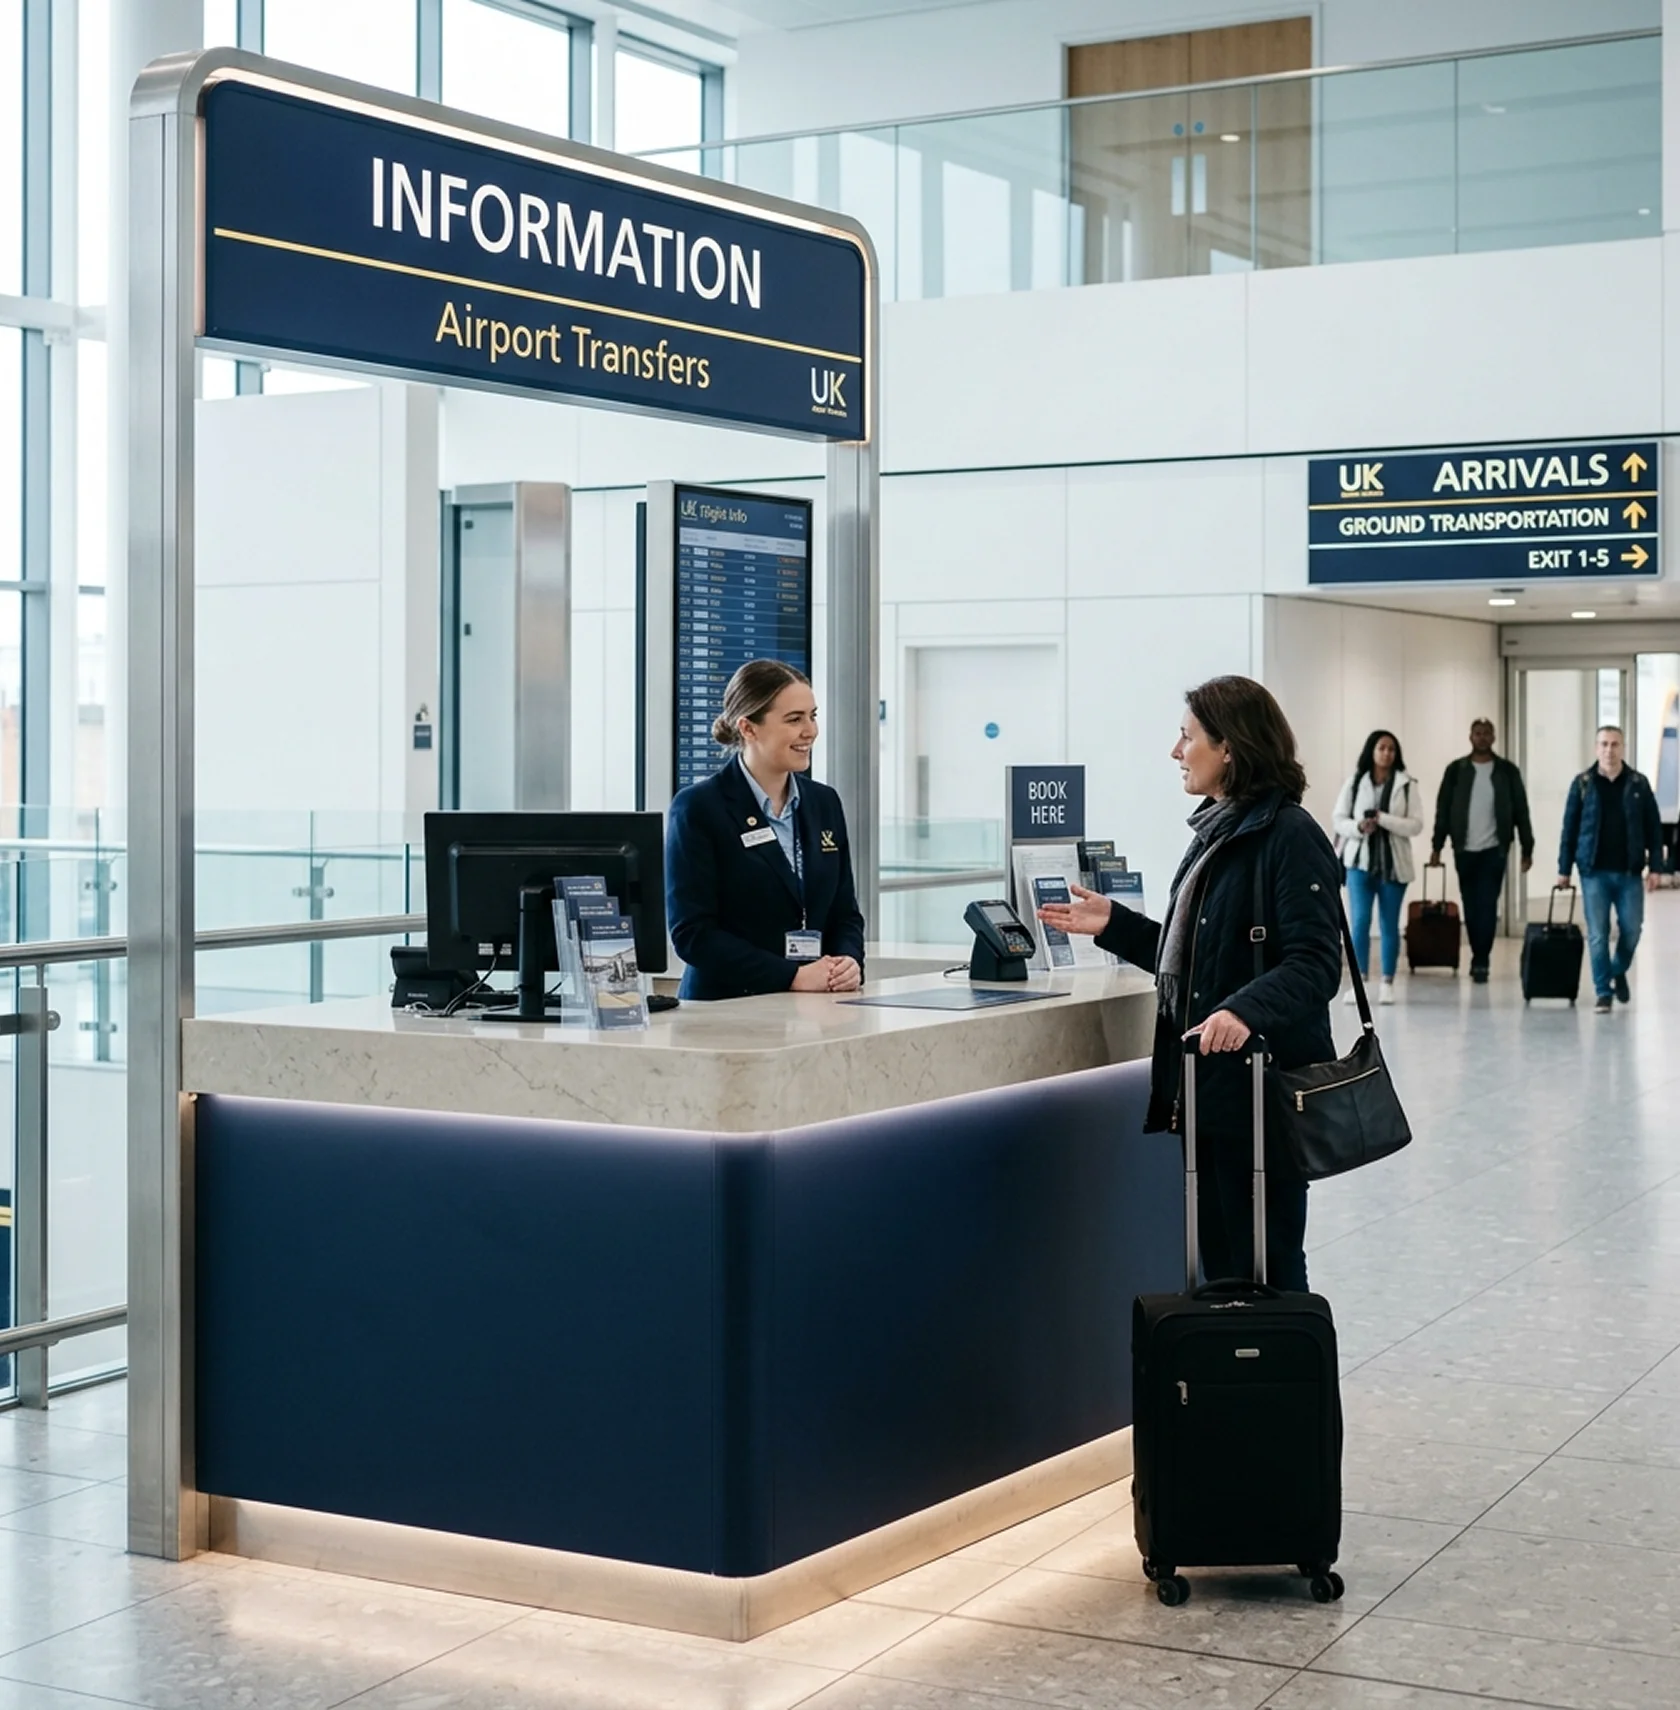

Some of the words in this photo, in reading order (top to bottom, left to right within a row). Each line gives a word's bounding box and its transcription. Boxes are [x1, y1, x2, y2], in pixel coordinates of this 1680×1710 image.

[372, 157, 761, 309] INFORMATION
[435, 302, 561, 363] Airport
[571, 325, 710, 388] Transfers
[811, 367, 846, 407] UK
[1339, 463, 1384, 491] UK
[1433, 454, 1609, 492] ARRIVALS
[1339, 514, 1425, 536] GROUND
[1430, 507, 1609, 533] TRANSPORTATION
[1528, 550, 1572, 569] EXIT
[1579, 548, 1610, 567] 1-5
[1028, 781, 1068, 800] BOOK
[1031, 805, 1065, 824] HERE
